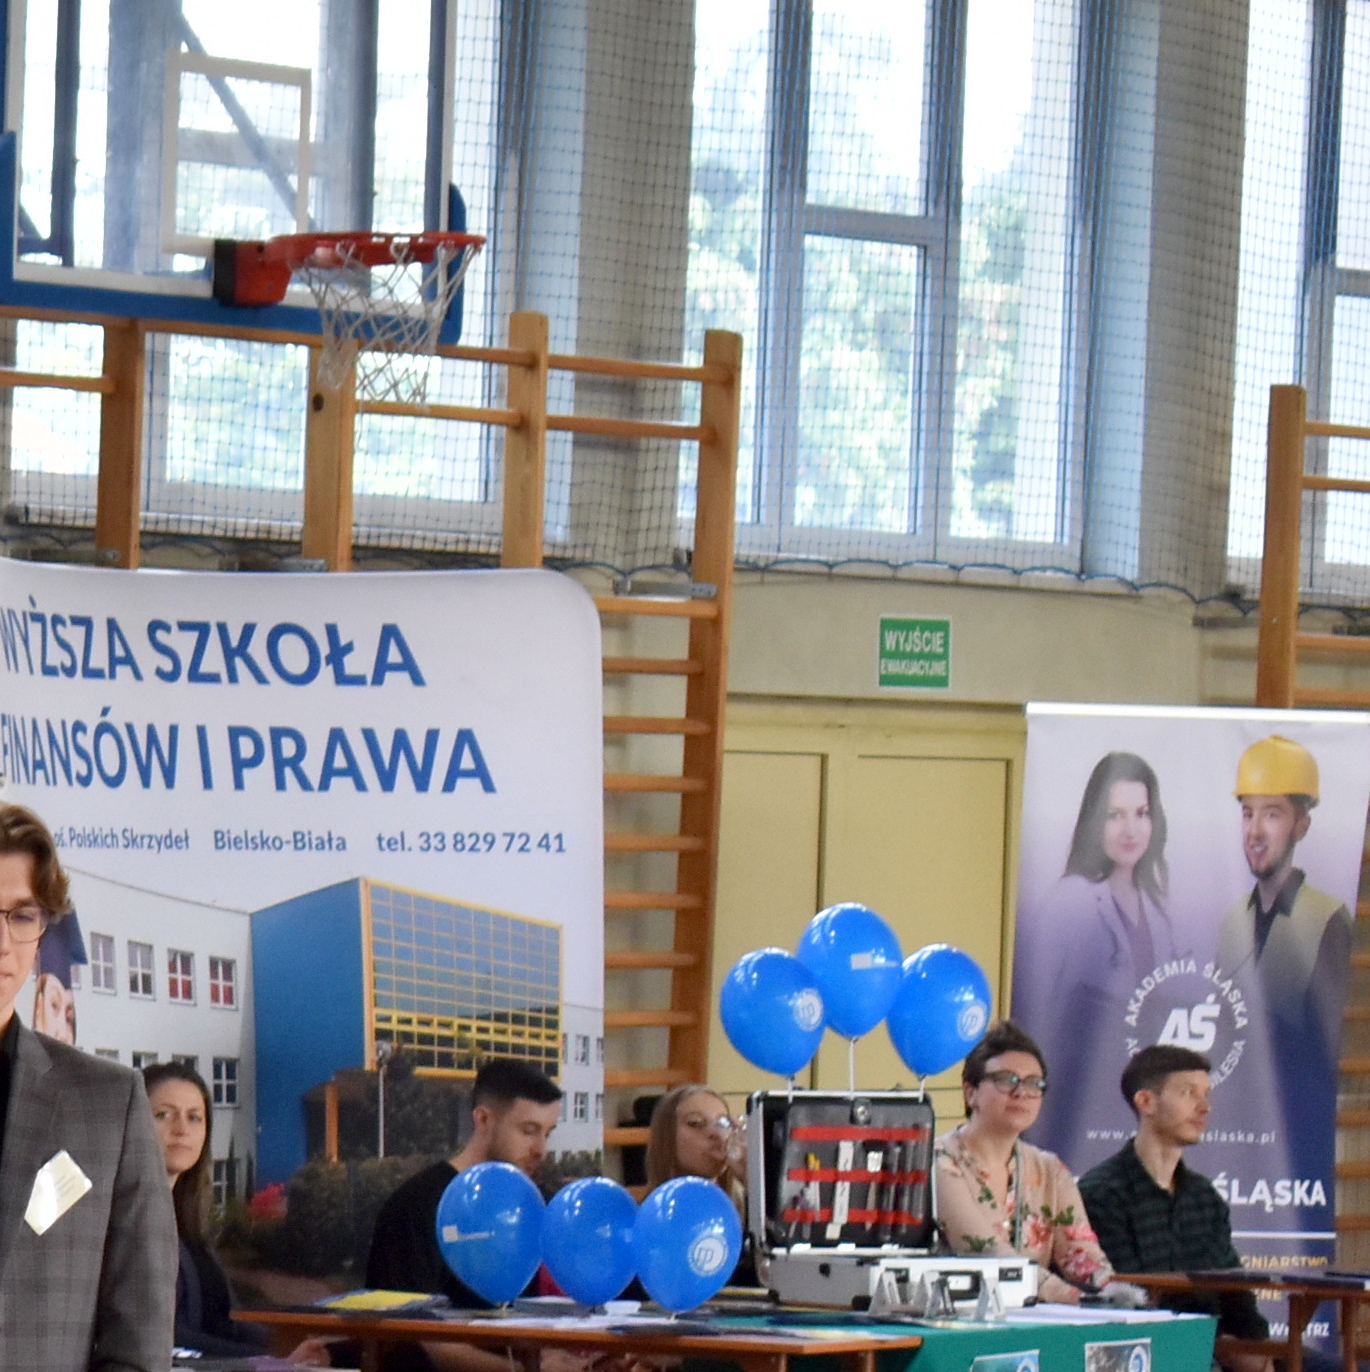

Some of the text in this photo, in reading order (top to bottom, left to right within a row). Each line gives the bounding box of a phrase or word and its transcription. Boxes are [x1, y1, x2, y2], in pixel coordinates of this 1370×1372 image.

[146, 617, 426, 687] SZKOŁA
[884, 625, 945, 654] WYJŚCIE
[0, 706, 497, 795] FINANSÓW I PRAWA
[68, 826, 119, 849] Polskich
[121, 827, 190, 854] Skrzydeł
[213, 829, 348, 852] Bielsko-Biała
[377, 831, 413, 854] tel.
[418, 832, 447, 854] 33
[452, 832, 497, 855] 829
[502, 832, 532, 854] 72
[536, 832, 567, 854] 41
[1124, 959, 1197, 1028] AKADEMIA
[1156, 992, 1221, 1052] AŚ
[1211, 1171, 1326, 1213] ŚLĄSKA
